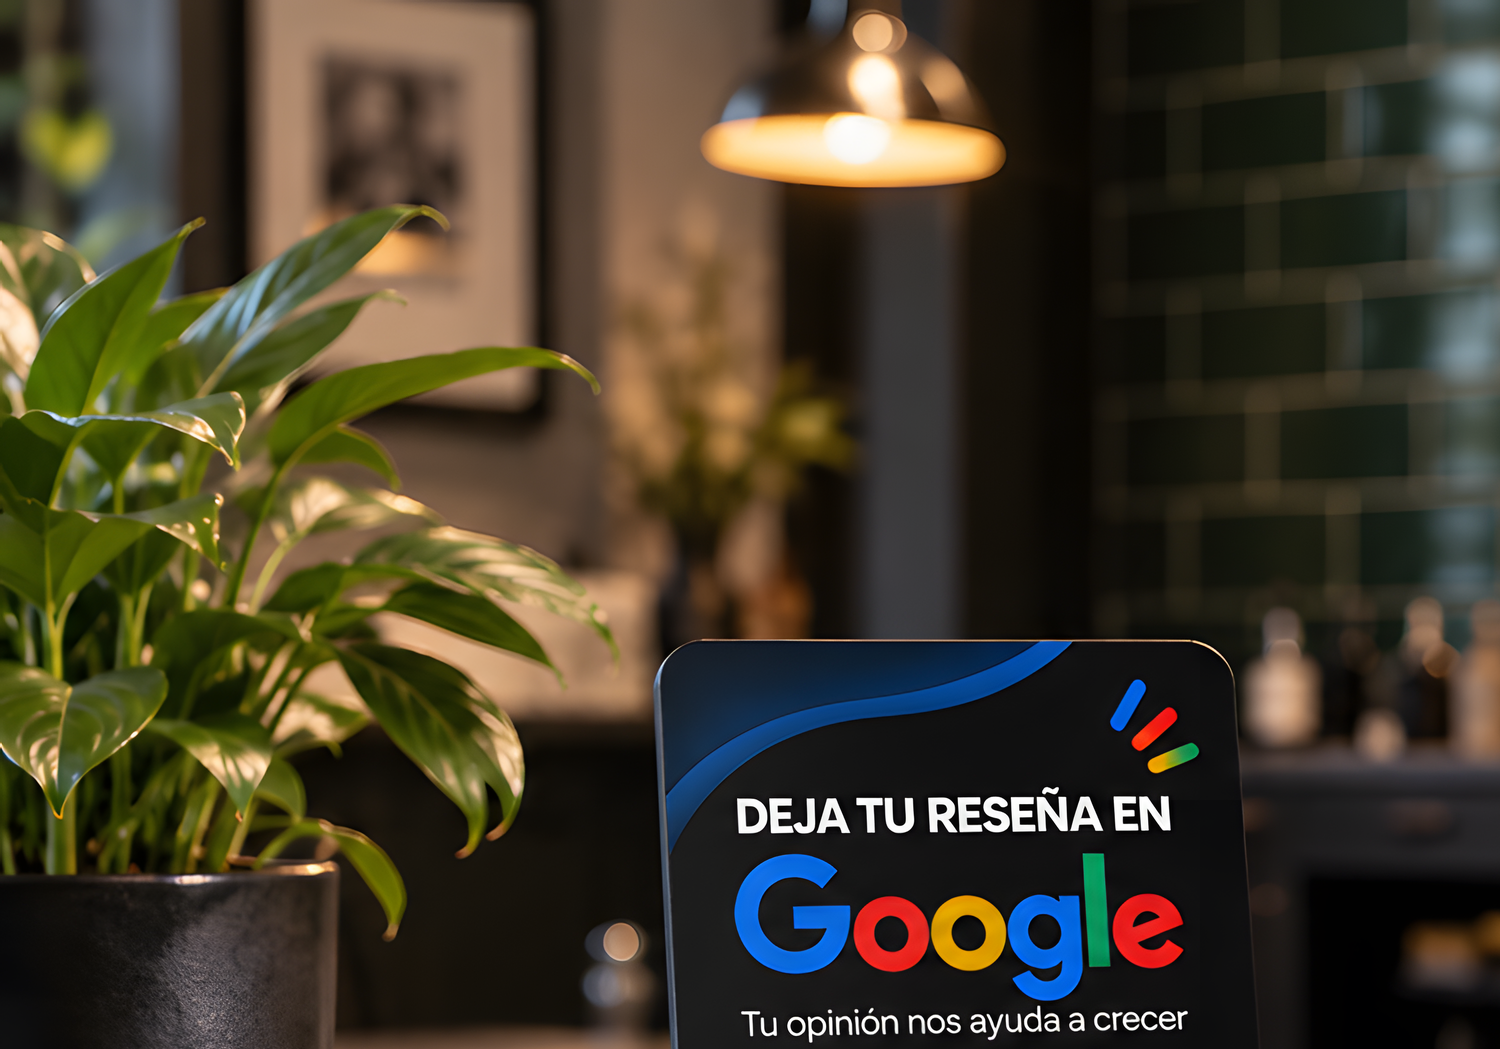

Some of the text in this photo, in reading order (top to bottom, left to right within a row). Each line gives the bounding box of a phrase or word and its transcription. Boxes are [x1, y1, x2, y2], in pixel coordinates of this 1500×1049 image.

[737, 787, 1171, 834] DEJA TU RESEÑA EN
[734, 854, 1183, 1001] Google
[741, 1006, 1188, 1043] Tu opinión nos ayuda a crecer
